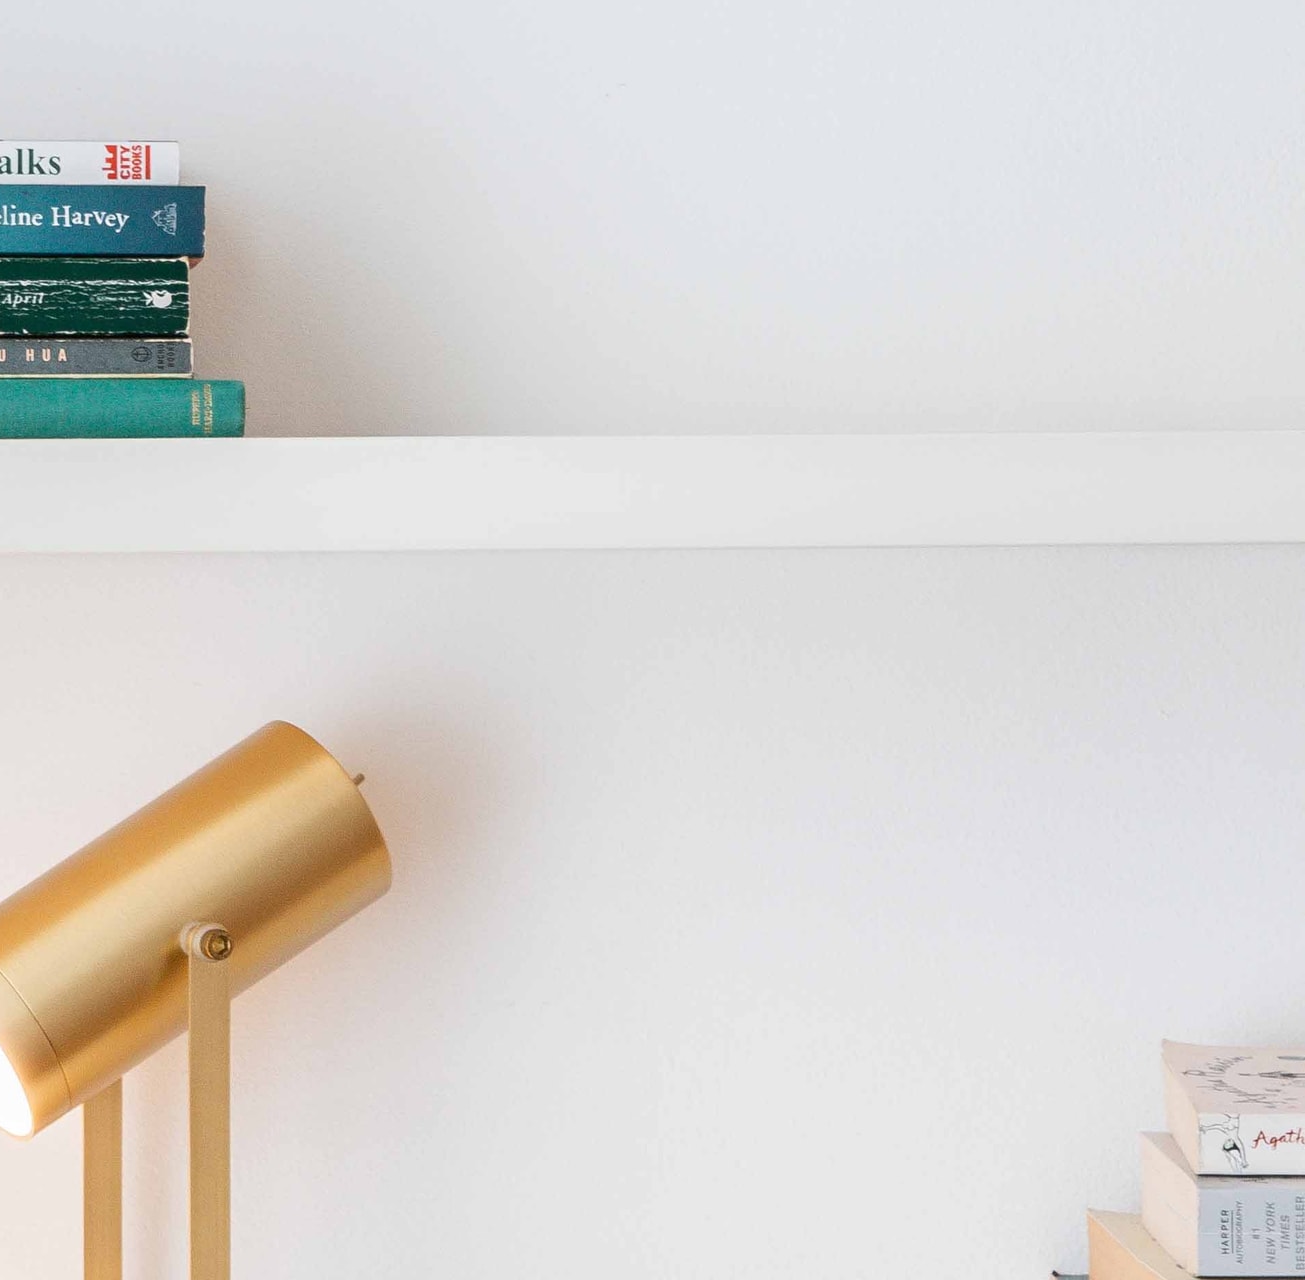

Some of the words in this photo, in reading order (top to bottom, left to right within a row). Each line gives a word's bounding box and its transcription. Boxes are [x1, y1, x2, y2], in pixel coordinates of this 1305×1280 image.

[120, 145, 131, 180] CITY
[132, 144, 143, 180] BOOKS
[51, 205, 130, 232] Harvey
[2, 292, 44, 307] April
[26, 348, 68, 363] HUA
[1220, 1209, 1230, 1255] HARPER
[1235, 1200, 1244, 1264] AUTOBIOGRAPHY
[1265, 1201, 1276, 1233] YORK
[1280, 1214, 1291, 1250] TIMES
[1295, 1195, 1305, 1271] BESTSELLER
[1265, 1237, 1276, 1264] NEW
